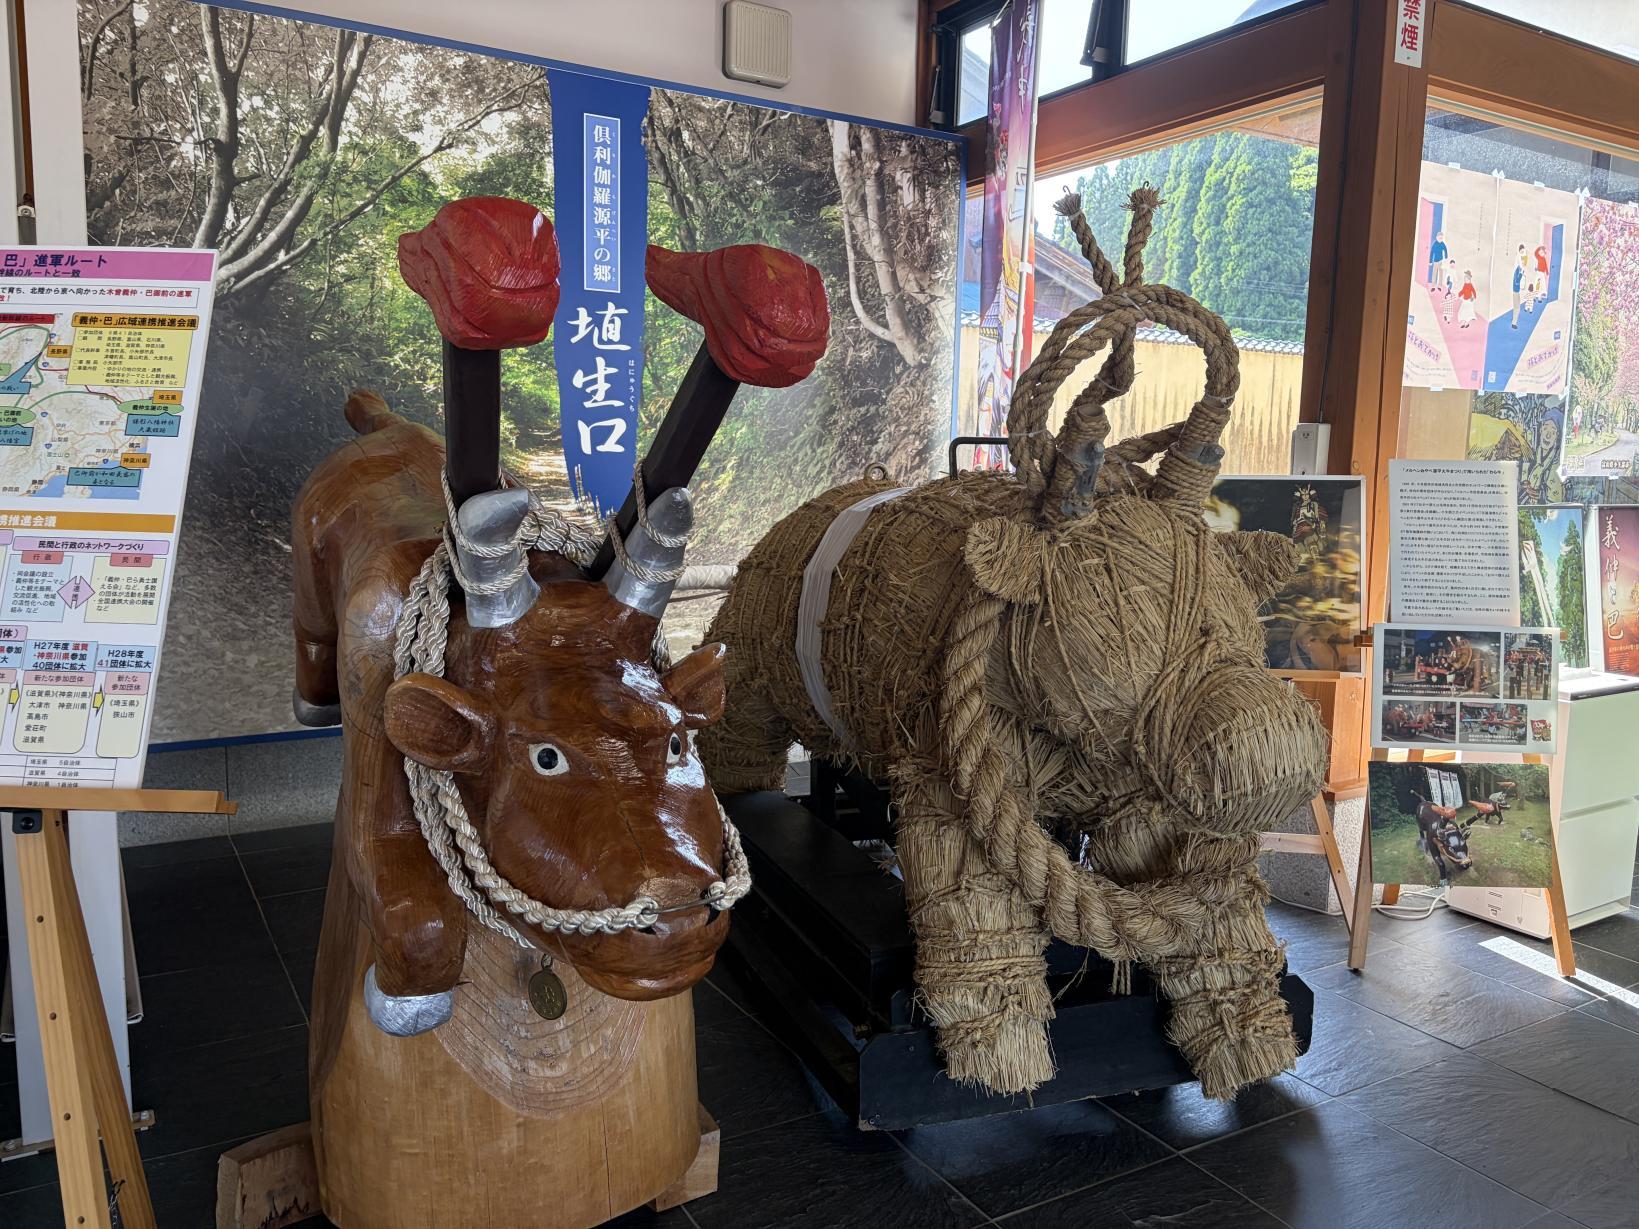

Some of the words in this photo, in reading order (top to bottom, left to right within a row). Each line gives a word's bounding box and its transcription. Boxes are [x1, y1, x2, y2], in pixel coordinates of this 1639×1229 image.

[1401, 0, 1421, 52] 禁煙
[567, 302, 632, 455] 埴生口
[628, 359, 636, 413] はにゅうぐち
[38, 540, 145, 551] 民間と行政のネットワークづくり
[108, 649, 145, 659] H28年度
